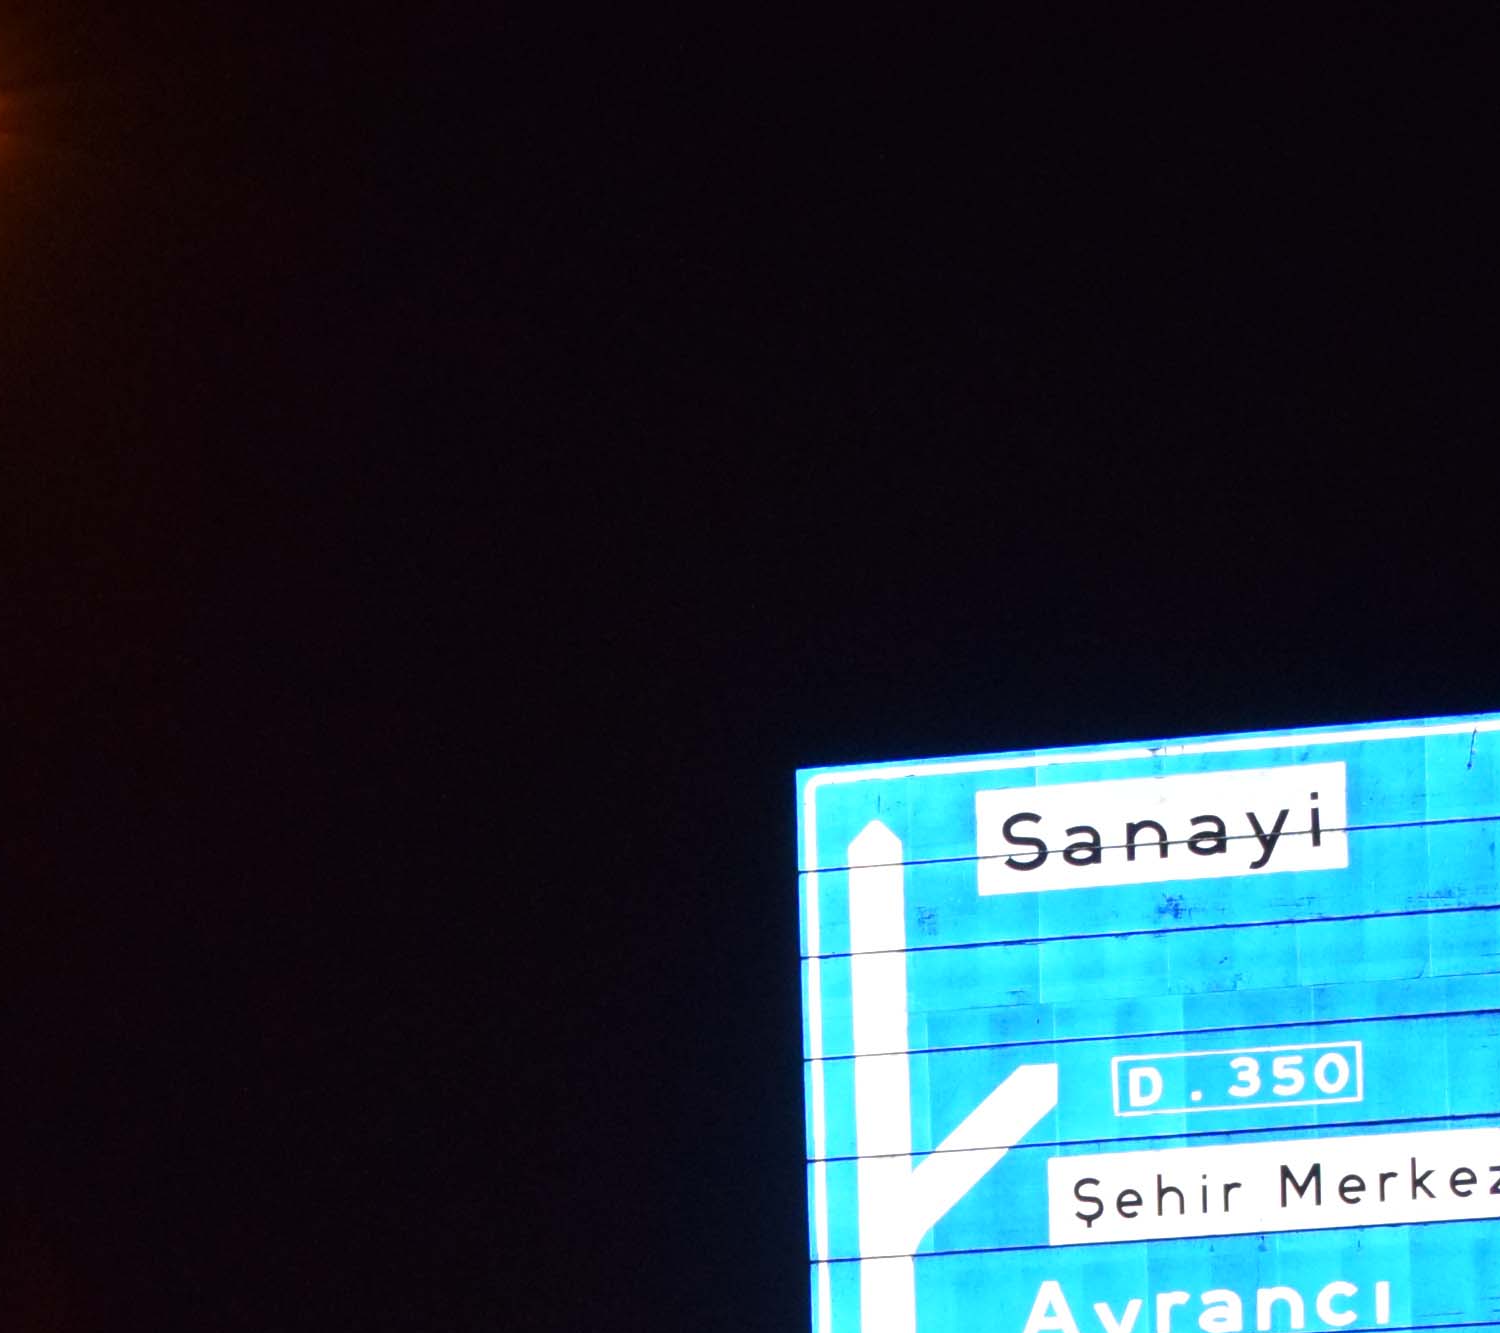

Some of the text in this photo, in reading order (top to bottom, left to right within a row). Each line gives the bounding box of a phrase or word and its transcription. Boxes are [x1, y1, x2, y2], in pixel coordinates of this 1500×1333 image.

[1002, 791, 1324, 872] Sanayi
[1228, 1052, 1350, 1098] 350
[1073, 1172, 1242, 1228] Şehir
